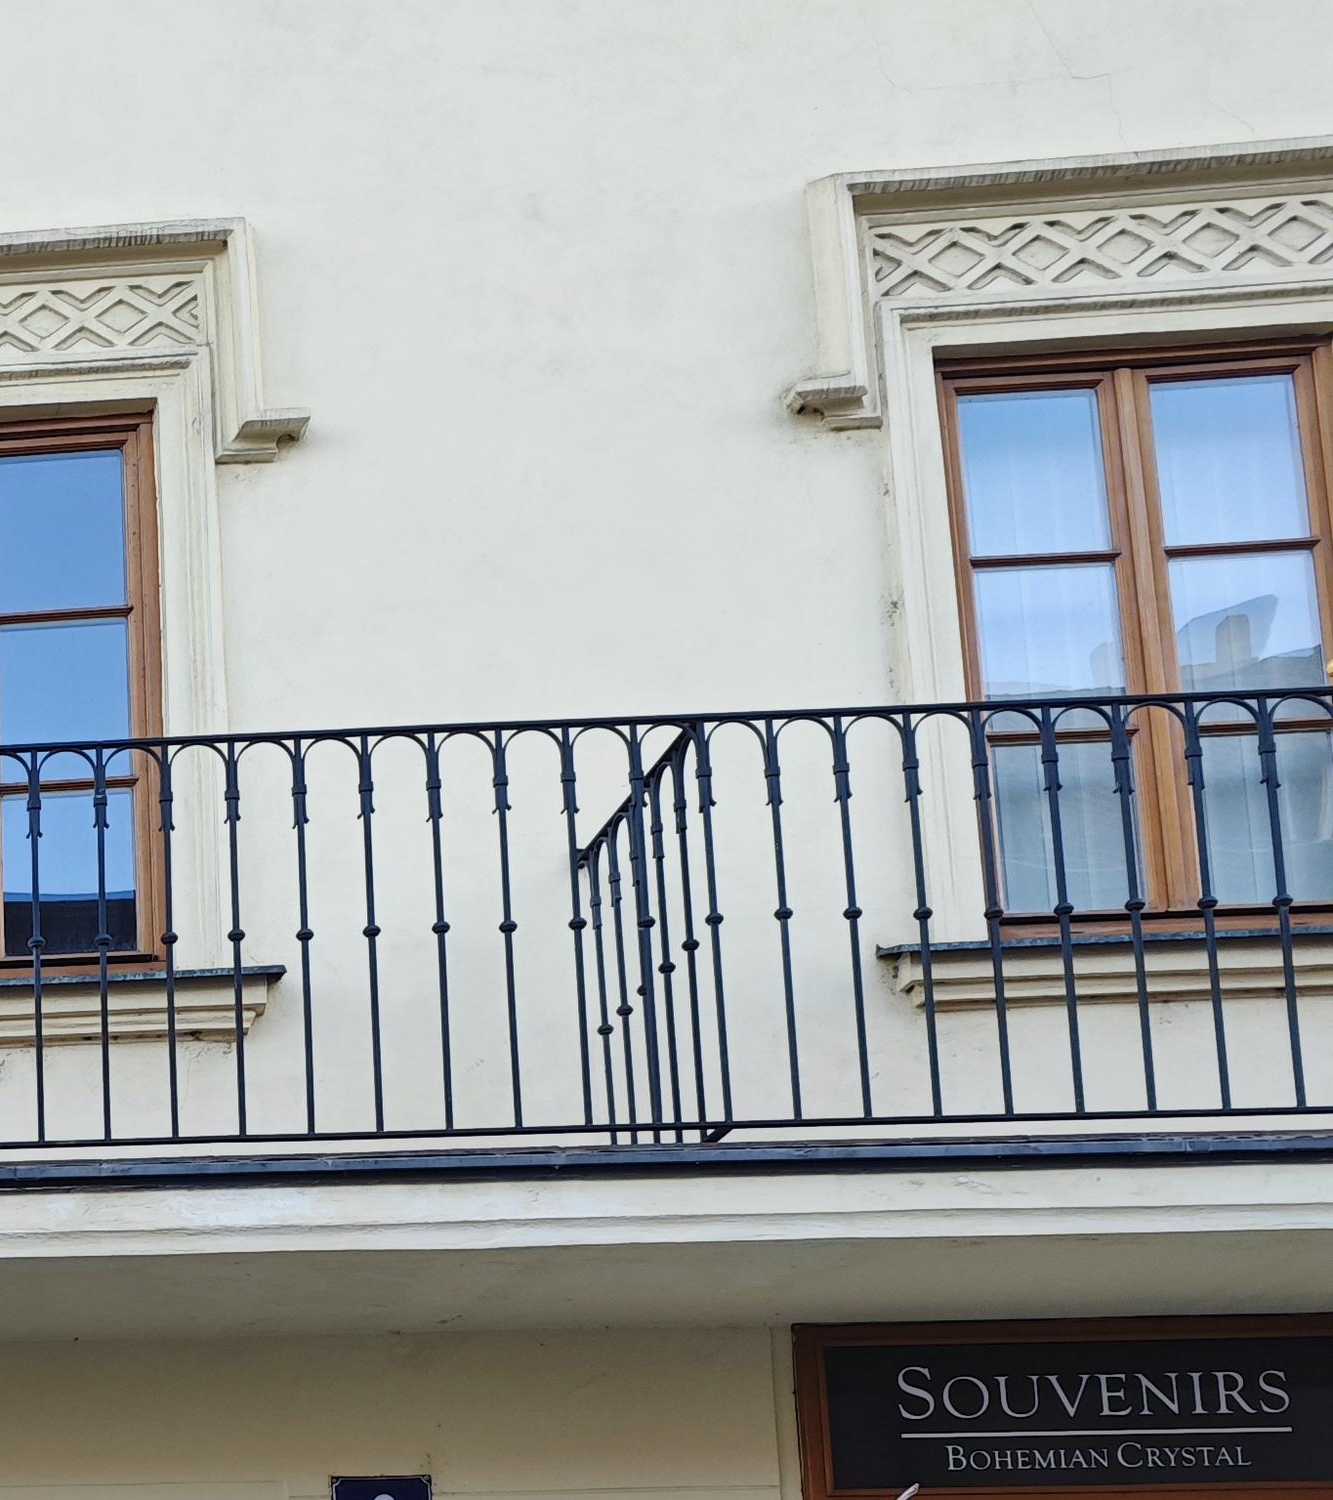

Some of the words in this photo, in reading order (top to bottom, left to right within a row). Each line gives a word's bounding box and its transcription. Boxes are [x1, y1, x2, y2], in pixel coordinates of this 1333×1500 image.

[897, 1366, 1291, 1420] SOUVENIRS
[945, 1444, 1109, 1472] BOHEMIAN
[1116, 1441, 1253, 1469] CRYSTAL
